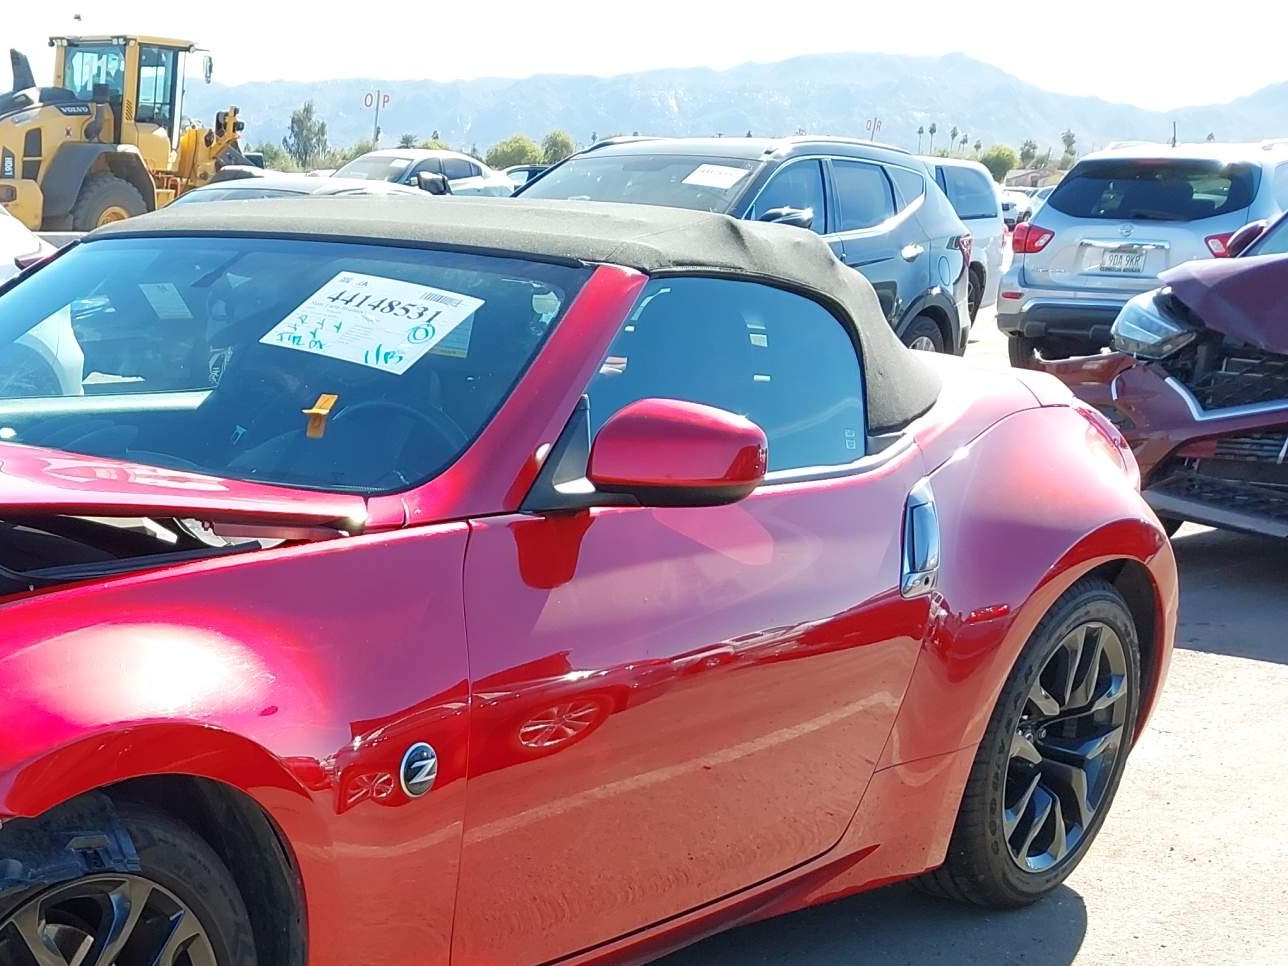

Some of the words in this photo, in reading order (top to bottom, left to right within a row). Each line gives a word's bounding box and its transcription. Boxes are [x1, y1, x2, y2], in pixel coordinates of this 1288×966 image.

[382, 94, 390, 108] P
[327, 290, 443, 324] 44148531
[408, 757, 436, 785] Z
